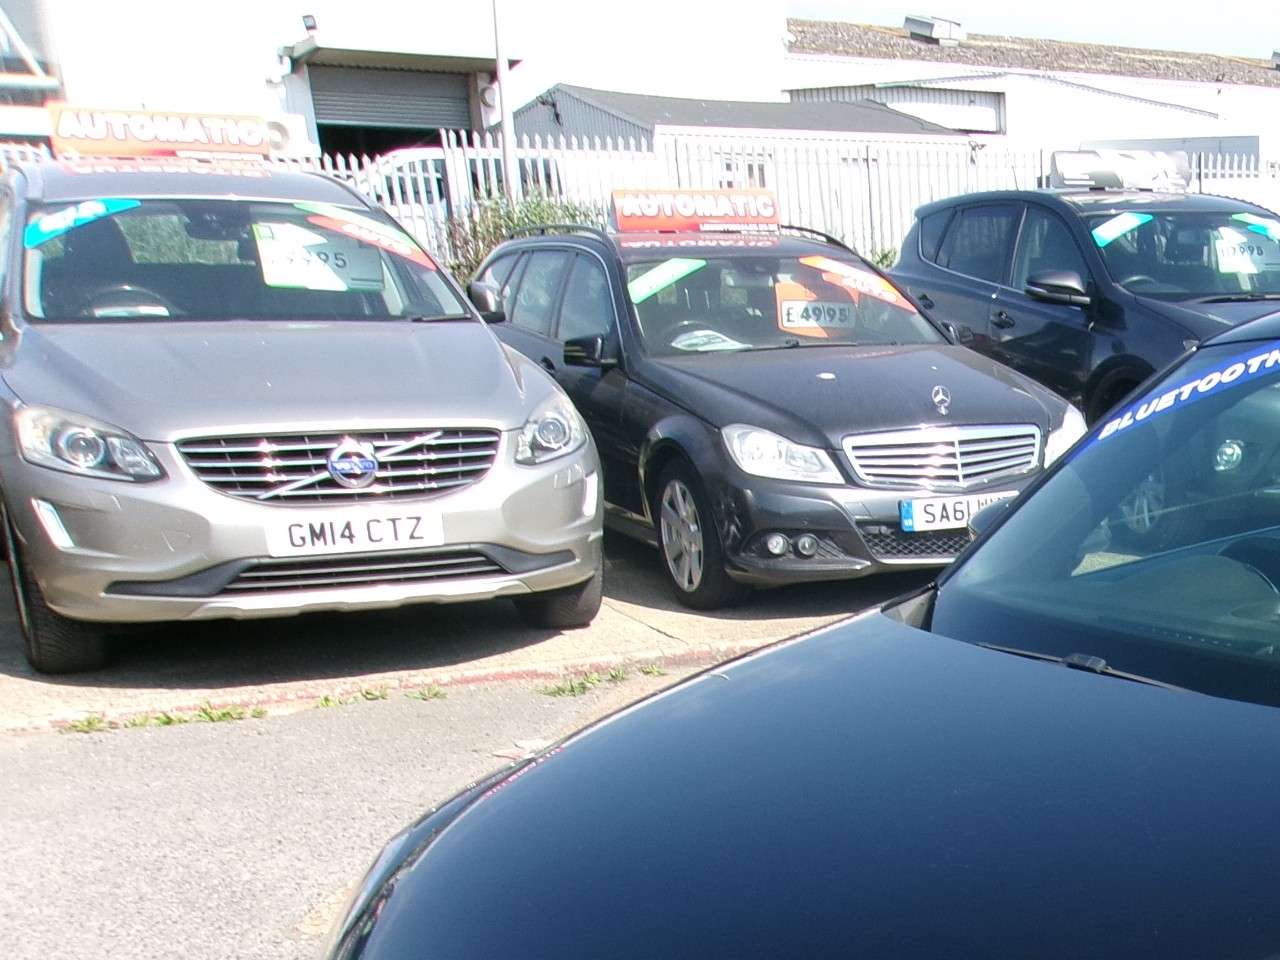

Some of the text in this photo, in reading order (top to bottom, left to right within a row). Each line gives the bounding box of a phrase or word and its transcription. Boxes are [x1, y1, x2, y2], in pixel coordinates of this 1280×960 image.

[57, 111, 266, 147] AUTOMATIC
[622, 193, 775, 218] AUTOMATIC
[288, 516, 424, 548] GM14 CTZ
